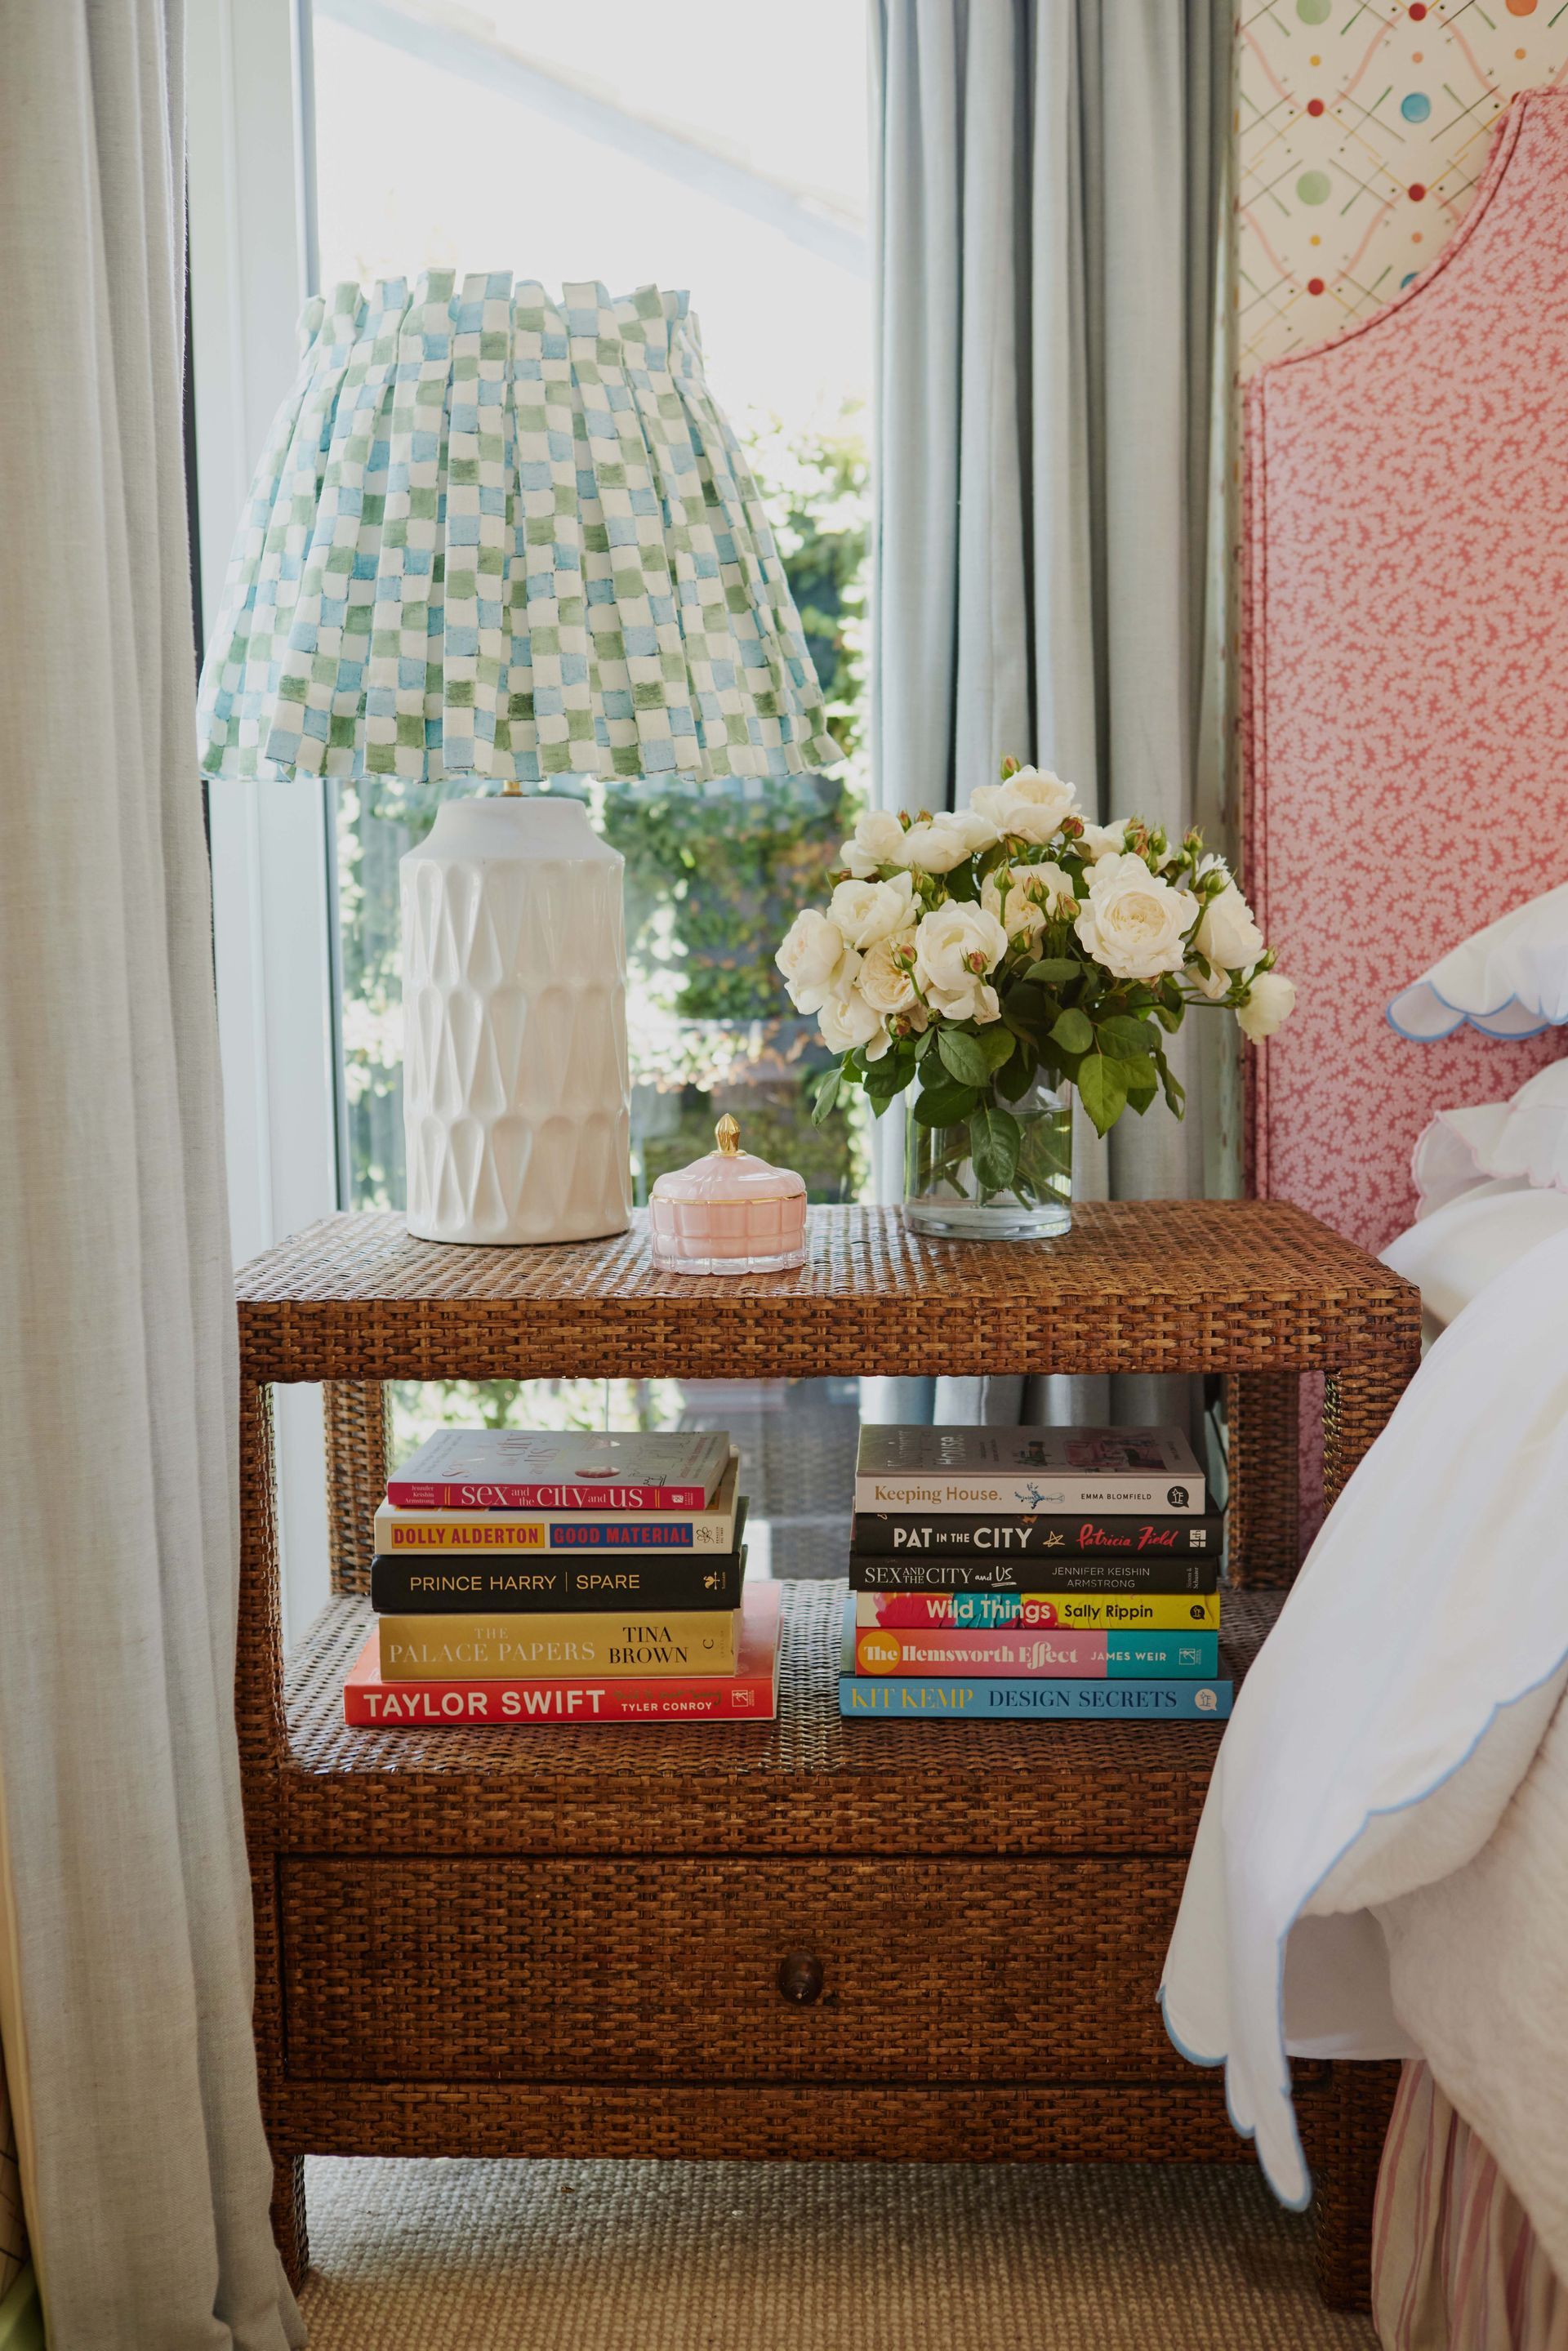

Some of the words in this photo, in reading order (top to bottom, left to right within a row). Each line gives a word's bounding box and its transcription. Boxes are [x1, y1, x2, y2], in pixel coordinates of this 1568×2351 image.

[461, 1485, 510, 1506] sex
[511, 1488, 529, 1497] and
[537, 1485, 590, 1507] city
[587, 1493, 607, 1503] and
[608, 1488, 644, 1508] us
[875, 1485, 942, 1505] Keeping
[947, 1486, 1003, 1501] House.
[1080, 1493, 1104, 1501] EMMA
[1107, 1493, 1152, 1501] BLOMFIELD
[519, 1498, 535, 1507] the
[394, 1528, 445, 1544] DOLLY
[451, 1528, 538, 1544] ALDERTON
[554, 1528, 600, 1543] GOOD
[606, 1528, 690, 1543] MATERIAL
[893, 1527, 933, 1548] PAT
[936, 1533, 947, 1543] IN
[951, 1533, 970, 1543] THE
[973, 1527, 1033, 1549] CITY
[1076, 1524, 1134, 1551] Patricia
[1138, 1525, 1179, 1551] Field
[864, 1567, 902, 1583] SEX
[902, 1567, 924, 1575] AND
[902, 1575, 924, 1584] THE
[925, 1567, 973, 1584] CITY
[974, 1571, 992, 1582] and
[1052, 1567, 1104, 1576] JENNIFER
[1107, 1567, 1151, 1577] KEISHIN
[410, 1576, 483, 1592] PRINCE
[490, 1575, 557, 1591] HARRY
[576, 1574, 641, 1590] SPARE
[1067, 1579, 1136, 1589] ARMSTRONG
[926, 1600, 973, 1619] Wild
[980, 1600, 1051, 1624] Things
[1064, 1604, 1101, 1620] Sally
[1106, 1604, 1153, 1621] Rippin
[474, 1627, 510, 1640] THE
[622, 1626, 674, 1643] TINA
[389, 1643, 489, 1664] PALACE
[497, 1641, 595, 1662] PAPERS
[608, 1646, 689, 1664] BROWN
[863, 1645, 898, 1661] The
[902, 1645, 1014, 1663] Hemsworth
[1018, 1641, 1078, 1670] Effect
[1090, 1651, 1131, 1661] JAMES
[1134, 1652, 1168, 1662] WEIR
[363, 1691, 488, 1717] TAYLOR
[501, 1690, 606, 1716] SWIFT
[851, 1686, 896, 1708] KIT
[901, 1687, 974, 1709] KEMP
[988, 1690, 1072, 1708] DESIGN
[1079, 1690, 1178, 1708] SECRETS
[621, 1703, 659, 1712] TYLER
[662, 1702, 713, 1712] CONROY
